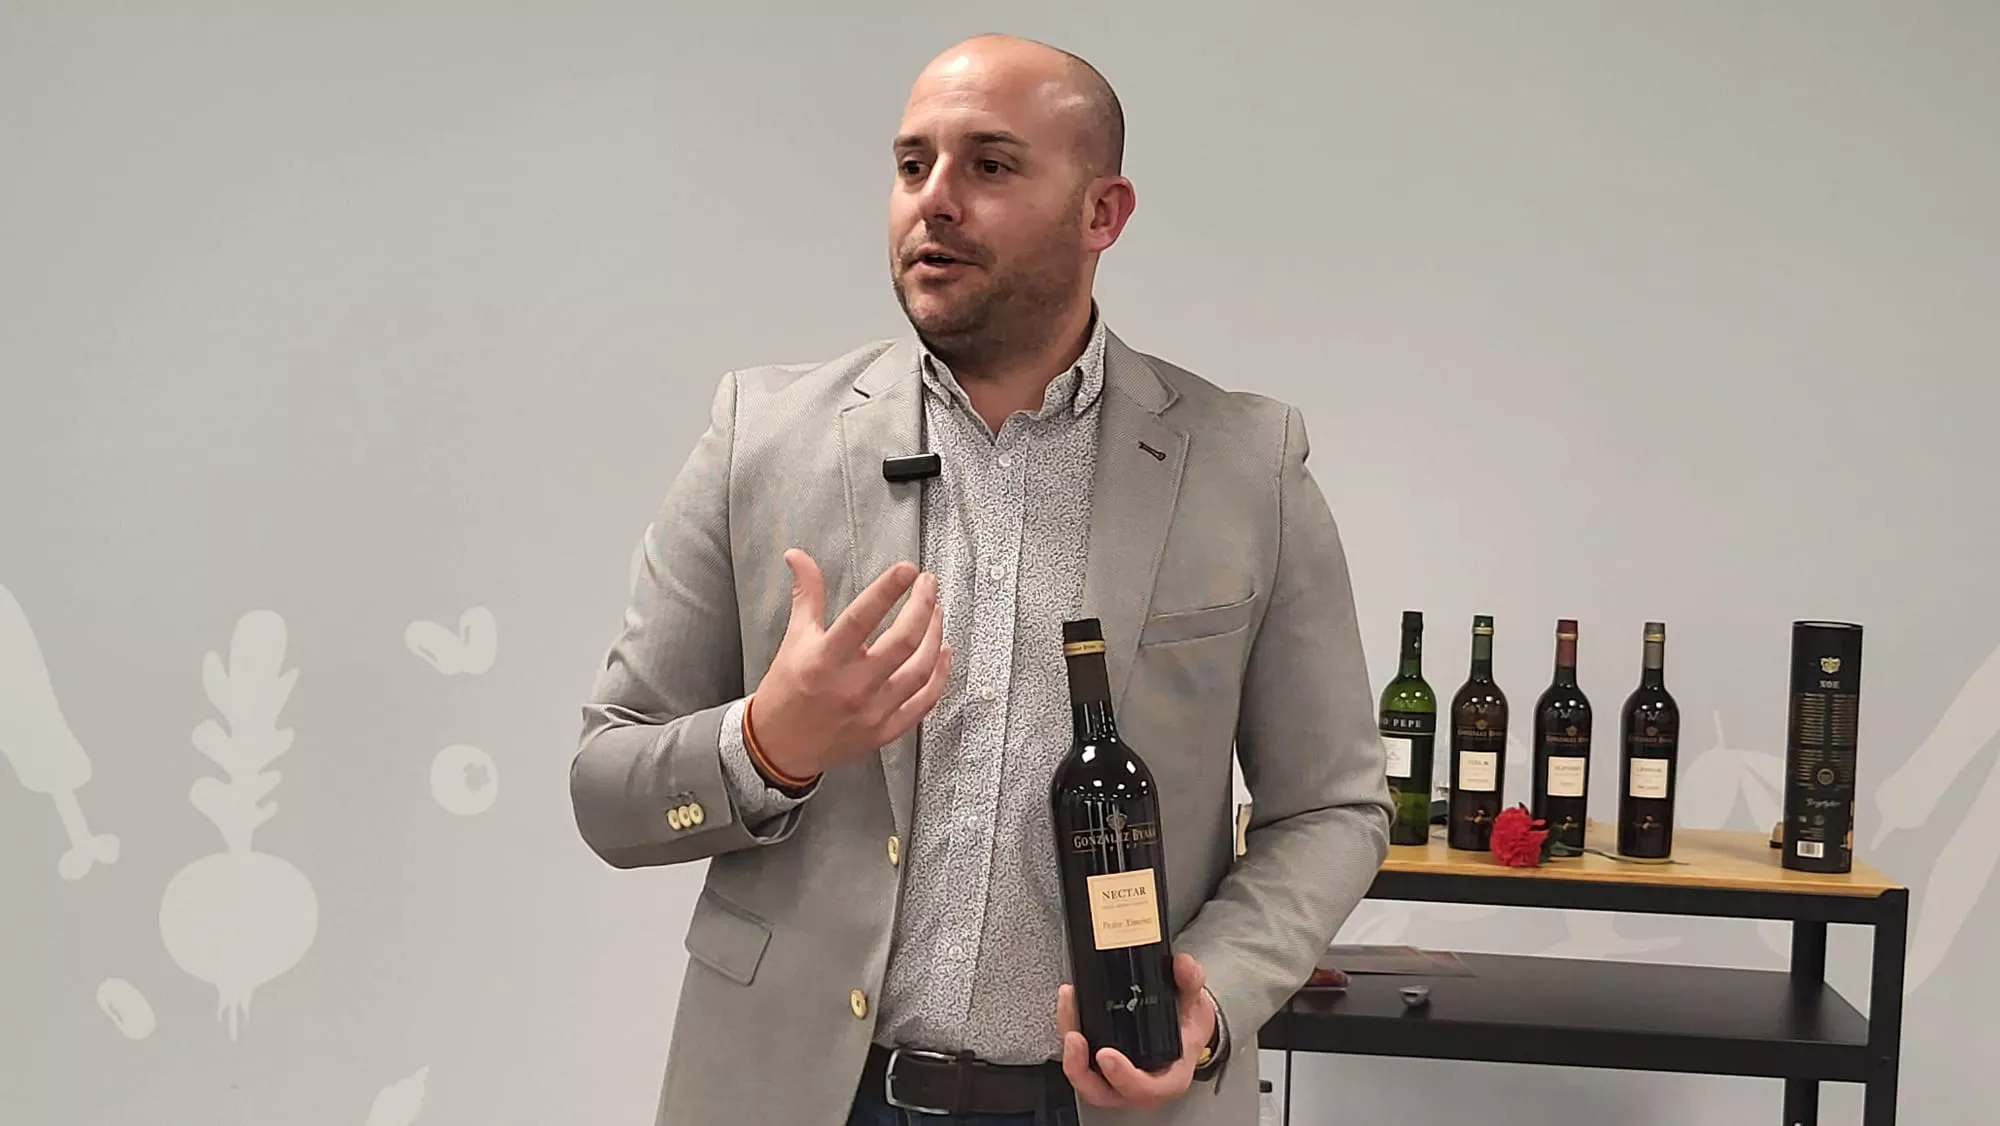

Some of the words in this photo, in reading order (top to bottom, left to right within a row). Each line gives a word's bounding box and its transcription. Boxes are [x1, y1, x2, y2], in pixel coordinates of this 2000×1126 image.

[1393, 718, 1421, 728] PEPE
[1073, 832, 1130, 849] GONZALEZ
[1102, 886, 1147, 900] NECTAR
